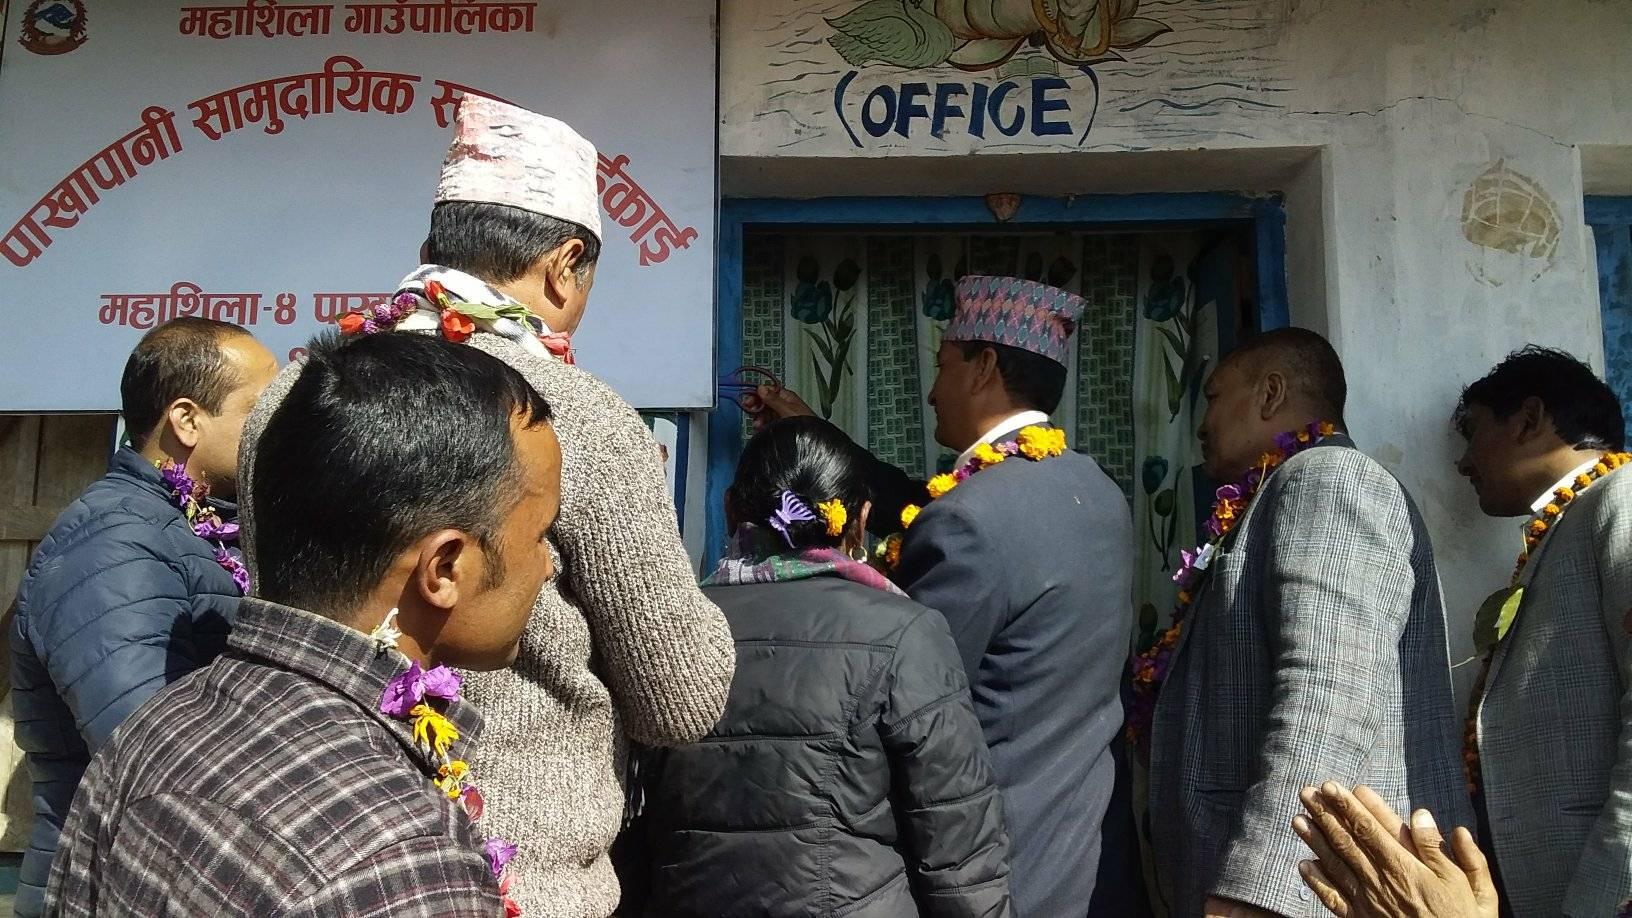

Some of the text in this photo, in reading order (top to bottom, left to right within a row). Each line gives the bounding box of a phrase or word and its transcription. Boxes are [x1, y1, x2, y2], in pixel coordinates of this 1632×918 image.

[179, 0, 334, 39] महाशिला
[0, 105, 183, 267] पाखापानी
[187, 55, 422, 140] सामुदायिक
